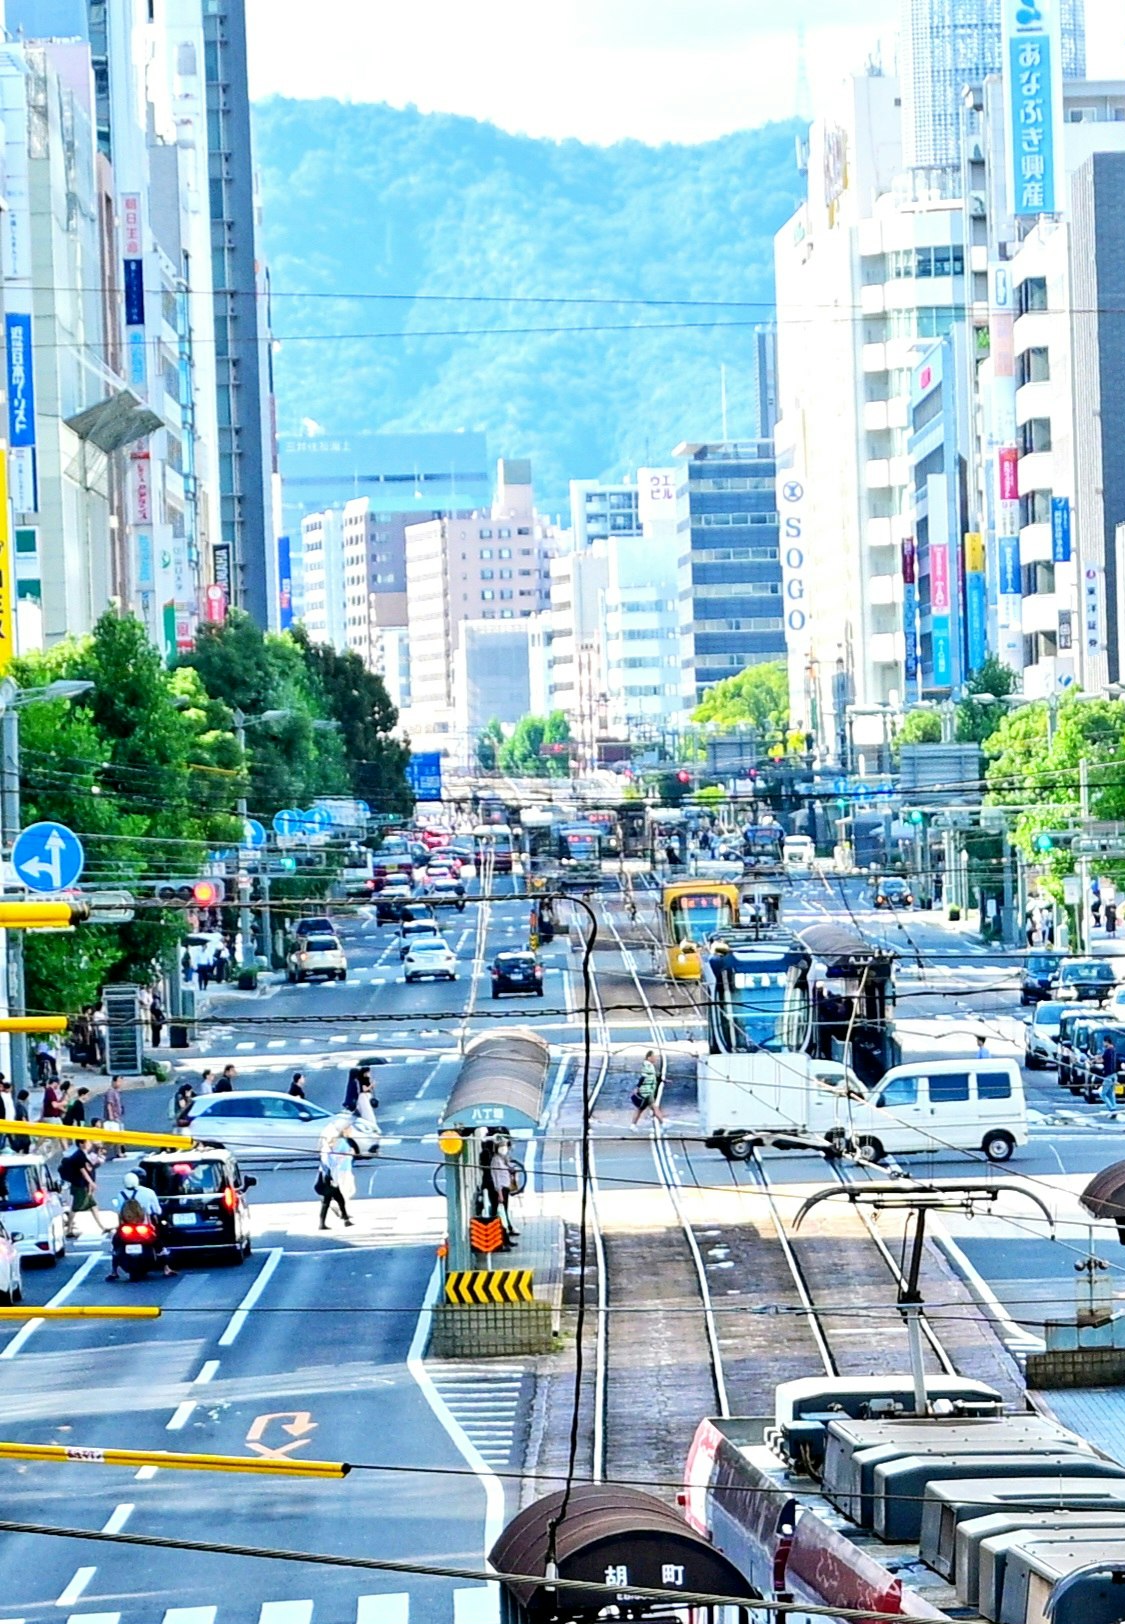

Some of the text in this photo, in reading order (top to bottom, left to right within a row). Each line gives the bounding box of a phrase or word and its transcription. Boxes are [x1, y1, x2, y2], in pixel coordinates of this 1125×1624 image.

[1018, 42, 1044, 207] あなぶき興産
[786, 517, 806, 631] SOGO
